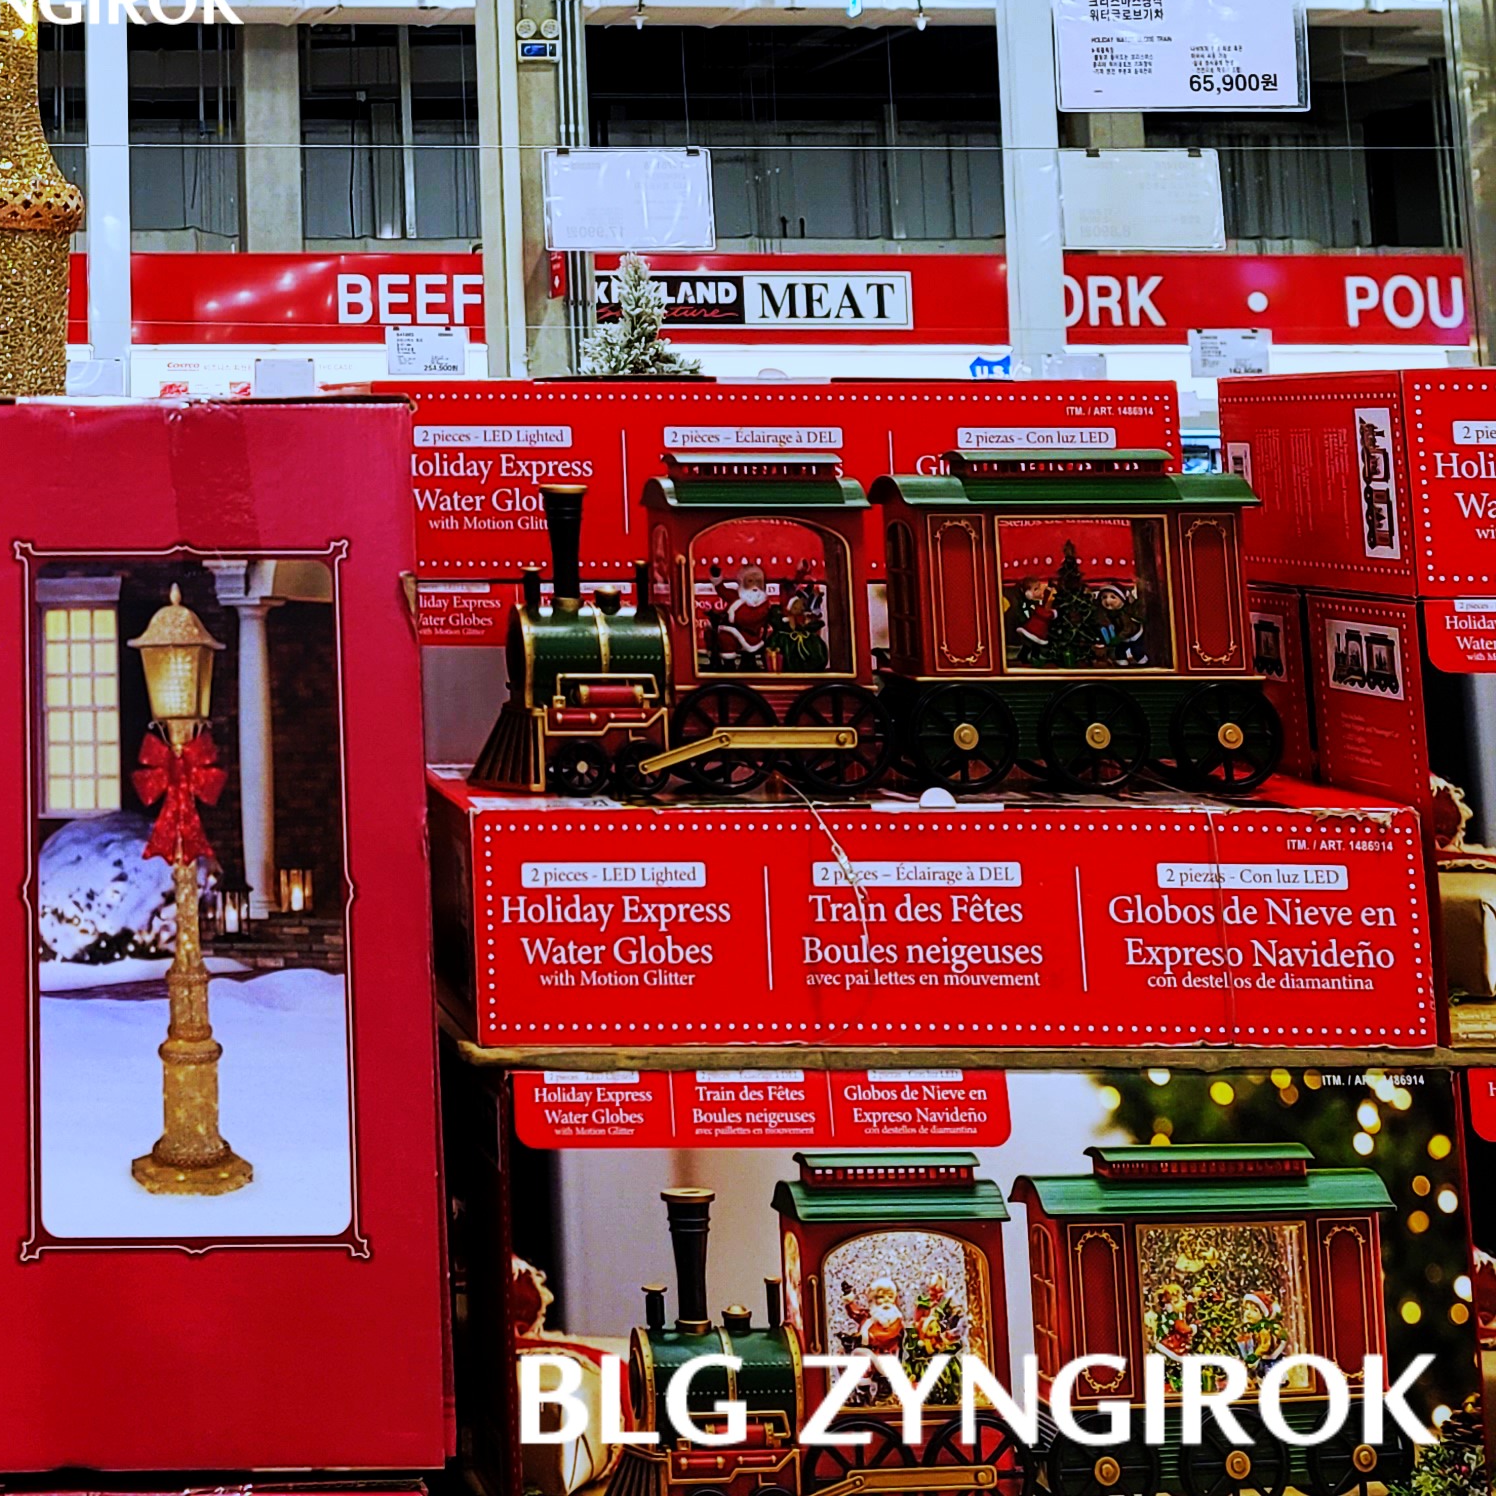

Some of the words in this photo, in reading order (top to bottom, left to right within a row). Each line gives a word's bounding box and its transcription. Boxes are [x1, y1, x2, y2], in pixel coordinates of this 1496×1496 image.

[1189, 72, 1279, 95] 65,900원
[337, 274, 484, 324] BEEF
[595, 281, 737, 304] KILAND
[758, 282, 895, 319] MEAT
[1345, 274, 1464, 329] POU
[1066, 406, 1086, 416] ITM.
[1093, 407, 1114, 416] ART.
[422, 430, 429, 442] 2
[433, 430, 471, 445] pieces
[483, 430, 512, 442] LED
[516, 429, 564, 446] Lighted
[671, 431, 678, 443] 2
[682, 430, 720, 446] pièces
[735, 427, 793, 447] Éclairage
[795, 431, 803, 443] à
[807, 431, 836, 444] DEL
[965, 432, 973, 444] 2
[976, 431, 1015, 447] piezas
[1026, 431, 1054, 445] Con
[1056, 431, 1076, 445] luz
[1080, 431, 1110, 445] LED
[1463, 426, 1472, 439] 2
[500, 453, 594, 485] Express
[1433, 451, 1496, 479] Holi
[413, 488, 486, 511] Water
[429, 516, 459, 530] with
[464, 516, 514, 530] Motion
[1476, 527, 1496, 540] wi
[453, 595, 501, 612] Express
[449, 613, 493, 626] Globes
[1287, 840, 1310, 850] ITM.
[1319, 840, 1345, 851] ART.
[1349, 840, 1393, 851] 1486914
[531, 868, 540, 881] 2
[544, 868, 588, 886] pieces
[602, 868, 636, 881] LED
[641, 867, 696, 886] Lighted
[821, 867, 829, 880] 2
[834, 868, 878, 885] pces
[896, 863, 962, 885] Éclairage
[967, 867, 975, 881] à
[979, 866, 1014, 882] DEL
[1166, 869, 1175, 882] 2
[1179, 868, 1225, 886] piezas
[1240, 869, 1272, 884] Con
[1277, 869, 1300, 884] luz
[1304, 870, 1339, 884] LED
[501, 894, 614, 932] Holiday
[622, 895, 731, 932] Express
[809, 895, 887, 922] Train
[895, 894, 942, 922] des
[950, 894, 1023, 922] Fêtes
[1108, 895, 1215, 925] Globos
[1223, 896, 1258, 925] de
[1264, 898, 1352, 926] Nieve
[1360, 908, 1397, 927] en
[520, 937, 606, 965] Water
[613, 935, 713, 965] Globes
[802, 935, 898, 964] Boules
[906, 937, 1043, 973] neigeuses
[1124, 937, 1243, 974] Expreso
[1250, 939, 1395, 969] Navideño
[540, 969, 575, 986] with
[580, 970, 639, 986] Motion
[644, 969, 695, 986] Glitter
[806, 974, 841, 985] avec
[845, 969, 915, 990] pailettes
[919, 975, 939, 985] en
[944, 972, 1041, 986] mouvement
[1147, 975, 1177, 988] con
[1182, 971, 1252, 989] destelos
[1256, 973, 1276, 989] de
[1280, 973, 1374, 990] diamantina
[1322, 1074, 1345, 1086] ITM.
[534, 1086, 592, 1106] Holiday
[596, 1087, 653, 1105] Express
[695, 1086, 736, 1101] Train
[739, 1085, 764, 1101] des
[767, 1085, 805, 1101] Fêtes
[843, 1085, 898, 1101] Globos
[900, 1085, 919, 1101] de
[921, 1085, 965, 1101] Nieve
[968, 1089, 987, 1101] en
[544, 1109, 588, 1124] Water
[590, 1108, 644, 1124] Globes
[692, 1108, 742, 1123] Boules
[745, 1108, 816, 1128] neigeuses
[852, 1107, 912, 1127] Expreso
[915, 1107, 987, 1123] Navideño
[554, 1127, 573, 1136] with
[575, 1127, 606, 1136] Motion
[608, 1127, 635, 1136] Glitter
[918, 1125, 929, 1134] de
